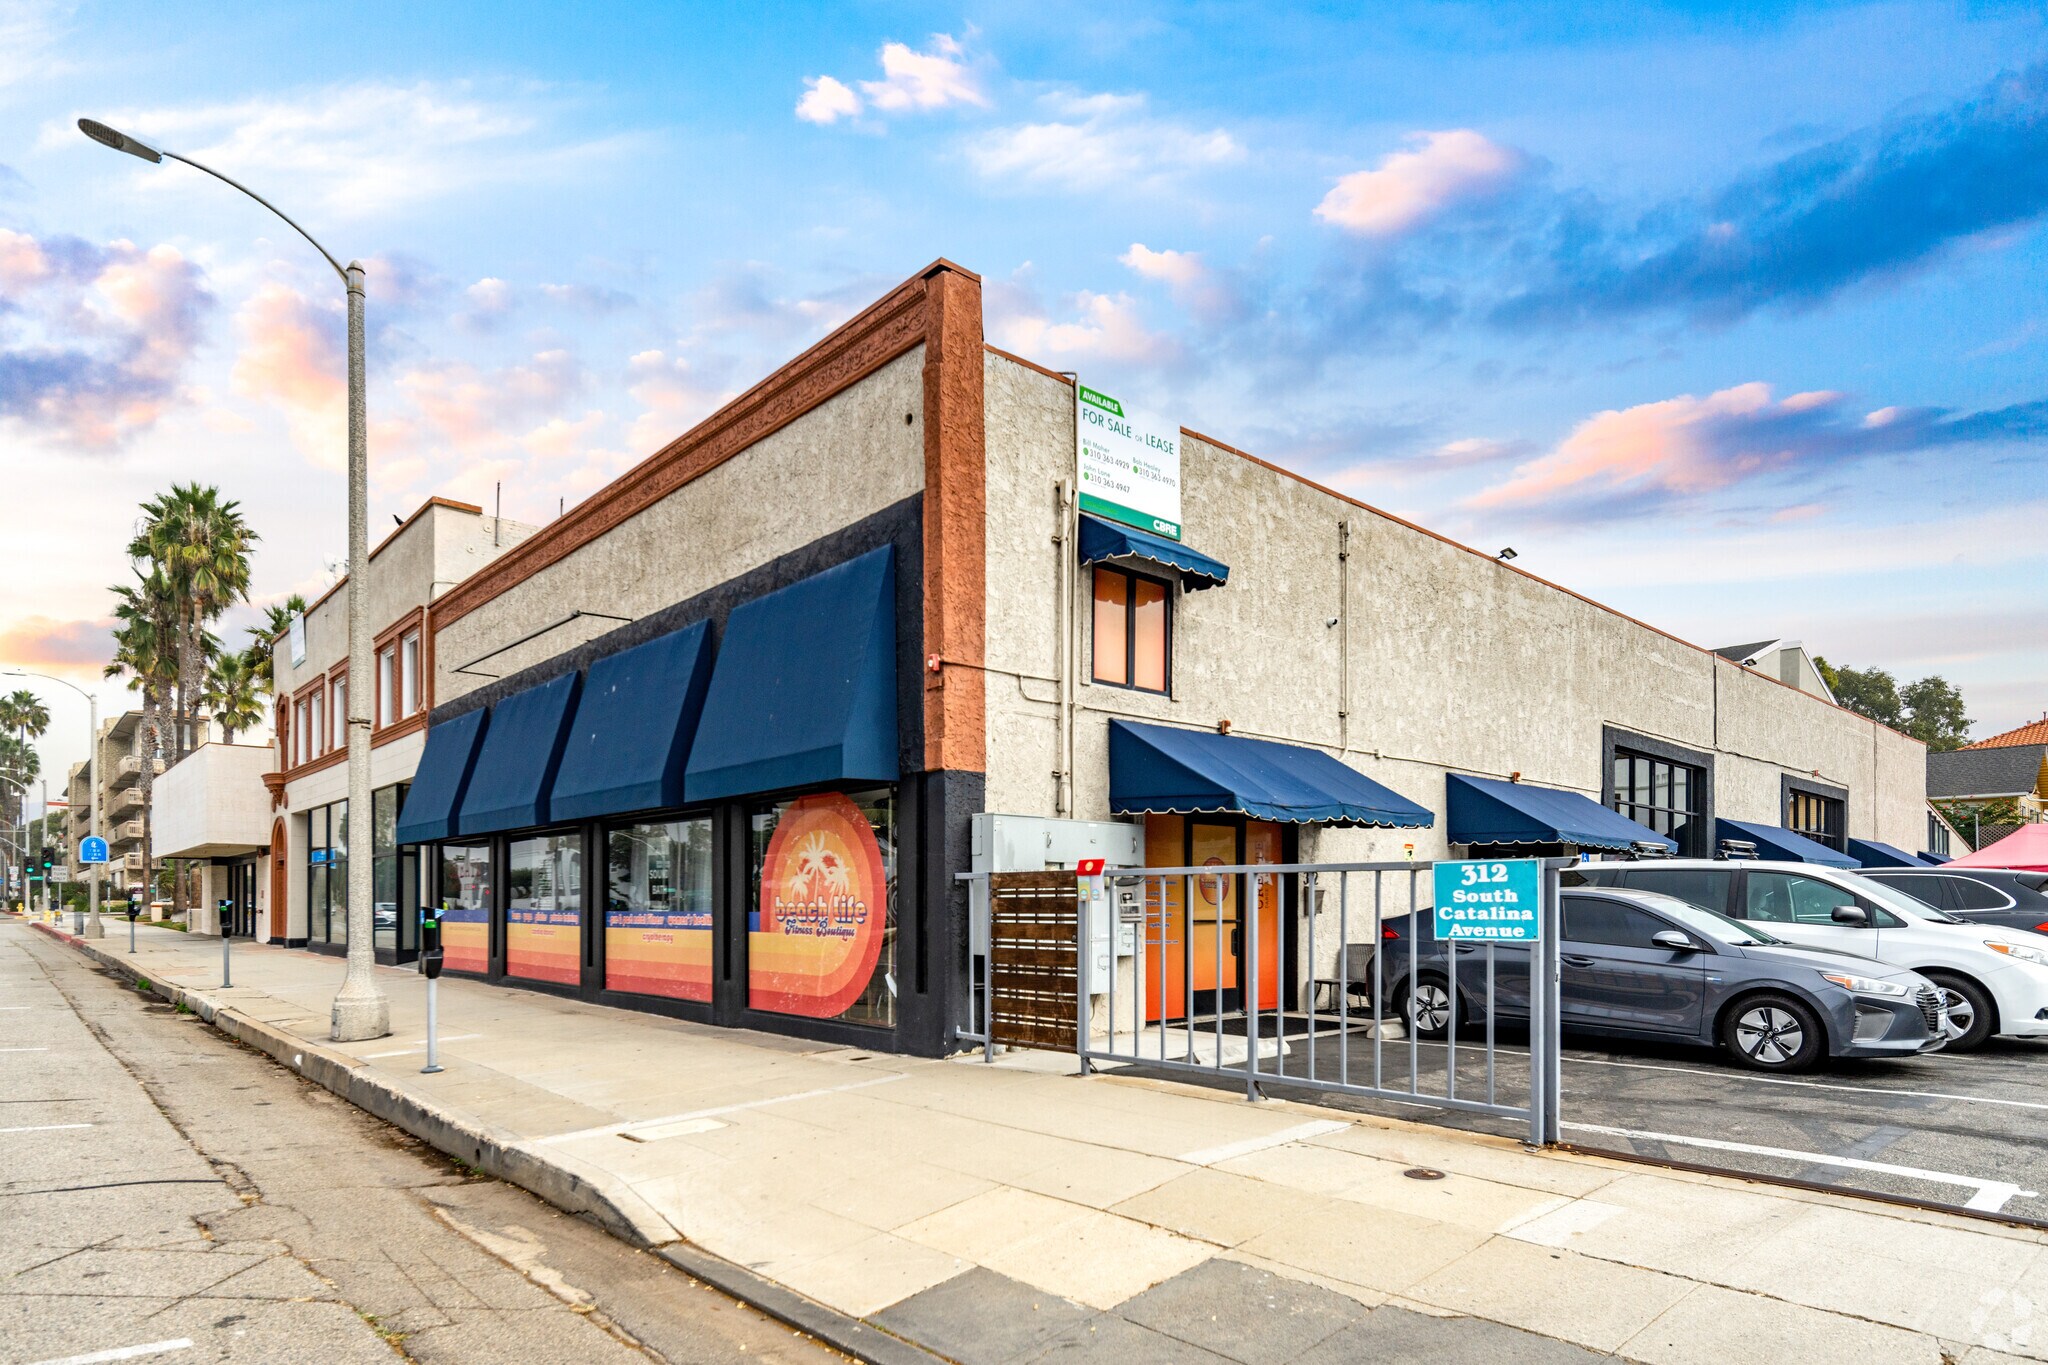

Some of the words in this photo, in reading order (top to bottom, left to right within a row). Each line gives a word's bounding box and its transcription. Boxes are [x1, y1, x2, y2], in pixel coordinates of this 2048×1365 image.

[1083, 390, 1119, 412] AVAILABLE
[1083, 408, 1104, 428] FOR
[1108, 418, 1132, 439] SALE
[1146, 433, 1174, 455] LEASE
[1083, 438, 1092, 446] Bill
[1090, 449, 1101, 460] 310
[1103, 453, 1114, 465] 363
[1115, 458, 1130, 470] 4929
[1090, 473, 1102, 484] 310
[1103, 478, 1114, 489] 363
[1115, 482, 1130, 494] 4947
[1139, 467, 1150, 478] 310
[1151, 471, 1161, 482] 363
[1162, 476, 1176, 487] 4970
[1153, 519, 1178, 536] CBRE
[1255, 838, 1265, 910] CRETE
[1461, 864, 1508, 886] 312
[1452, 889, 1519, 903] South
[775, 894, 829, 923] beach
[833, 893, 868, 924] life
[1438, 906, 1534, 920] Catalina
[785, 918, 813, 935] Fitness
[816, 917, 855, 941] Boutique
[1448, 923, 1525, 937] Avenue
